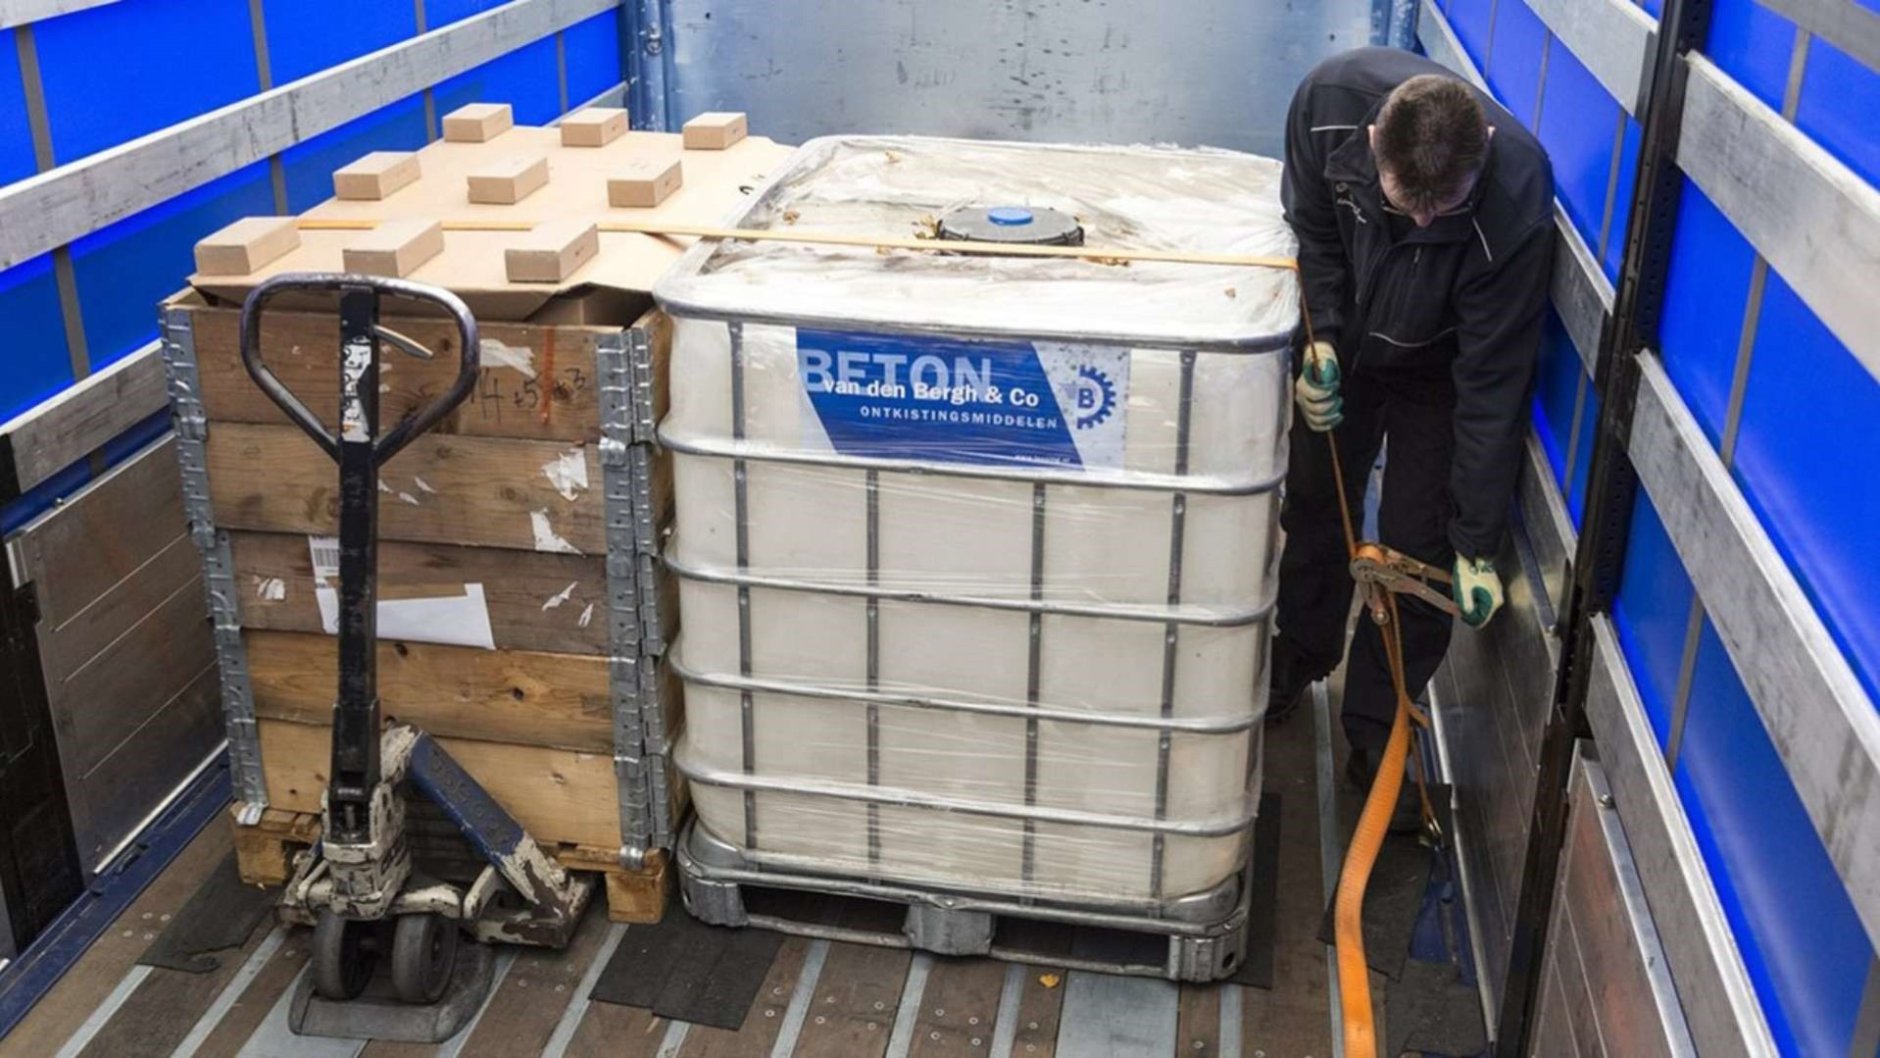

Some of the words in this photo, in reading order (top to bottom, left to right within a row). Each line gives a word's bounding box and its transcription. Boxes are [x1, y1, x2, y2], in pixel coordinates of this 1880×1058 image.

[797, 348, 992, 402] BETON
[823, 380, 861, 395] van
[867, 380, 906, 400] den
[913, 381, 977, 405] Bergh
[984, 386, 1004, 404] &
[1010, 388, 1040, 408] Co
[1078, 388, 1096, 409] B
[860, 406, 1058, 429] ONTKISTINGSMIDDELEN
